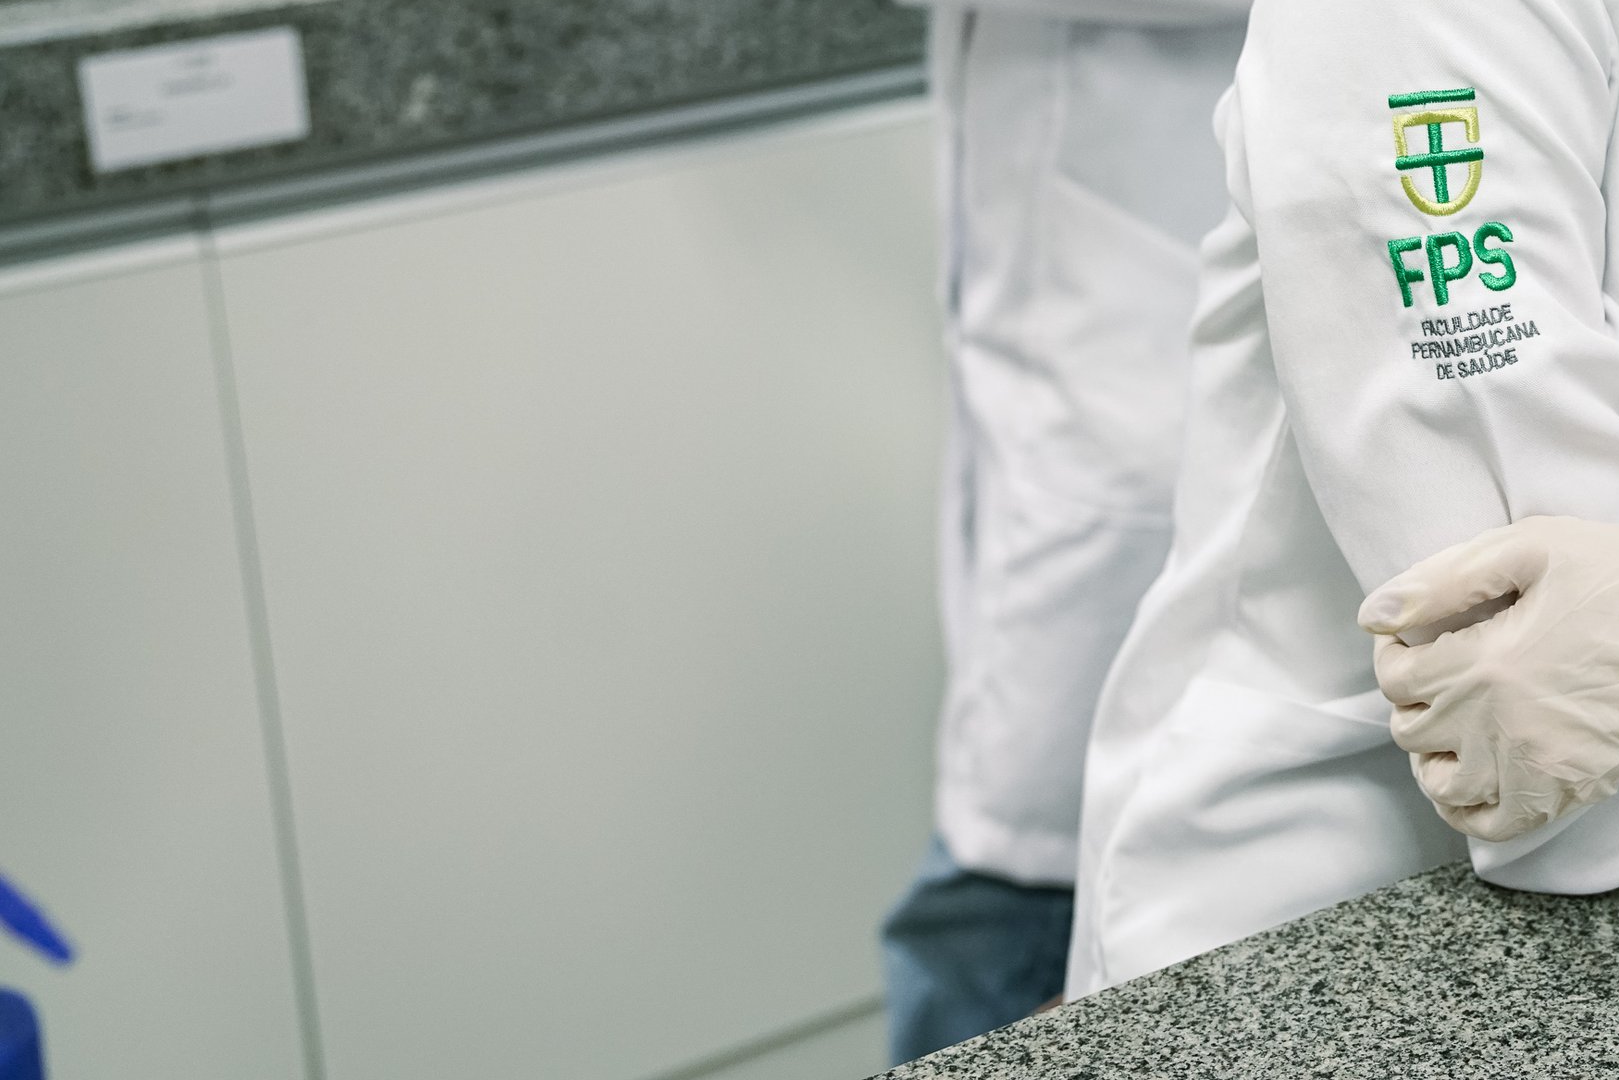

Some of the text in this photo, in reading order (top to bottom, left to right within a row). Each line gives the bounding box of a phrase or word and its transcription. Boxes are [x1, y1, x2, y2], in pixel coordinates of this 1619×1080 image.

[1387, 221, 1517, 308] FPS
[1420, 302, 1515, 337] FACULDADE
[1411, 320, 1540, 359] PERNAMBUCANA
[1436, 348, 1519, 380] DE SAÚDE
